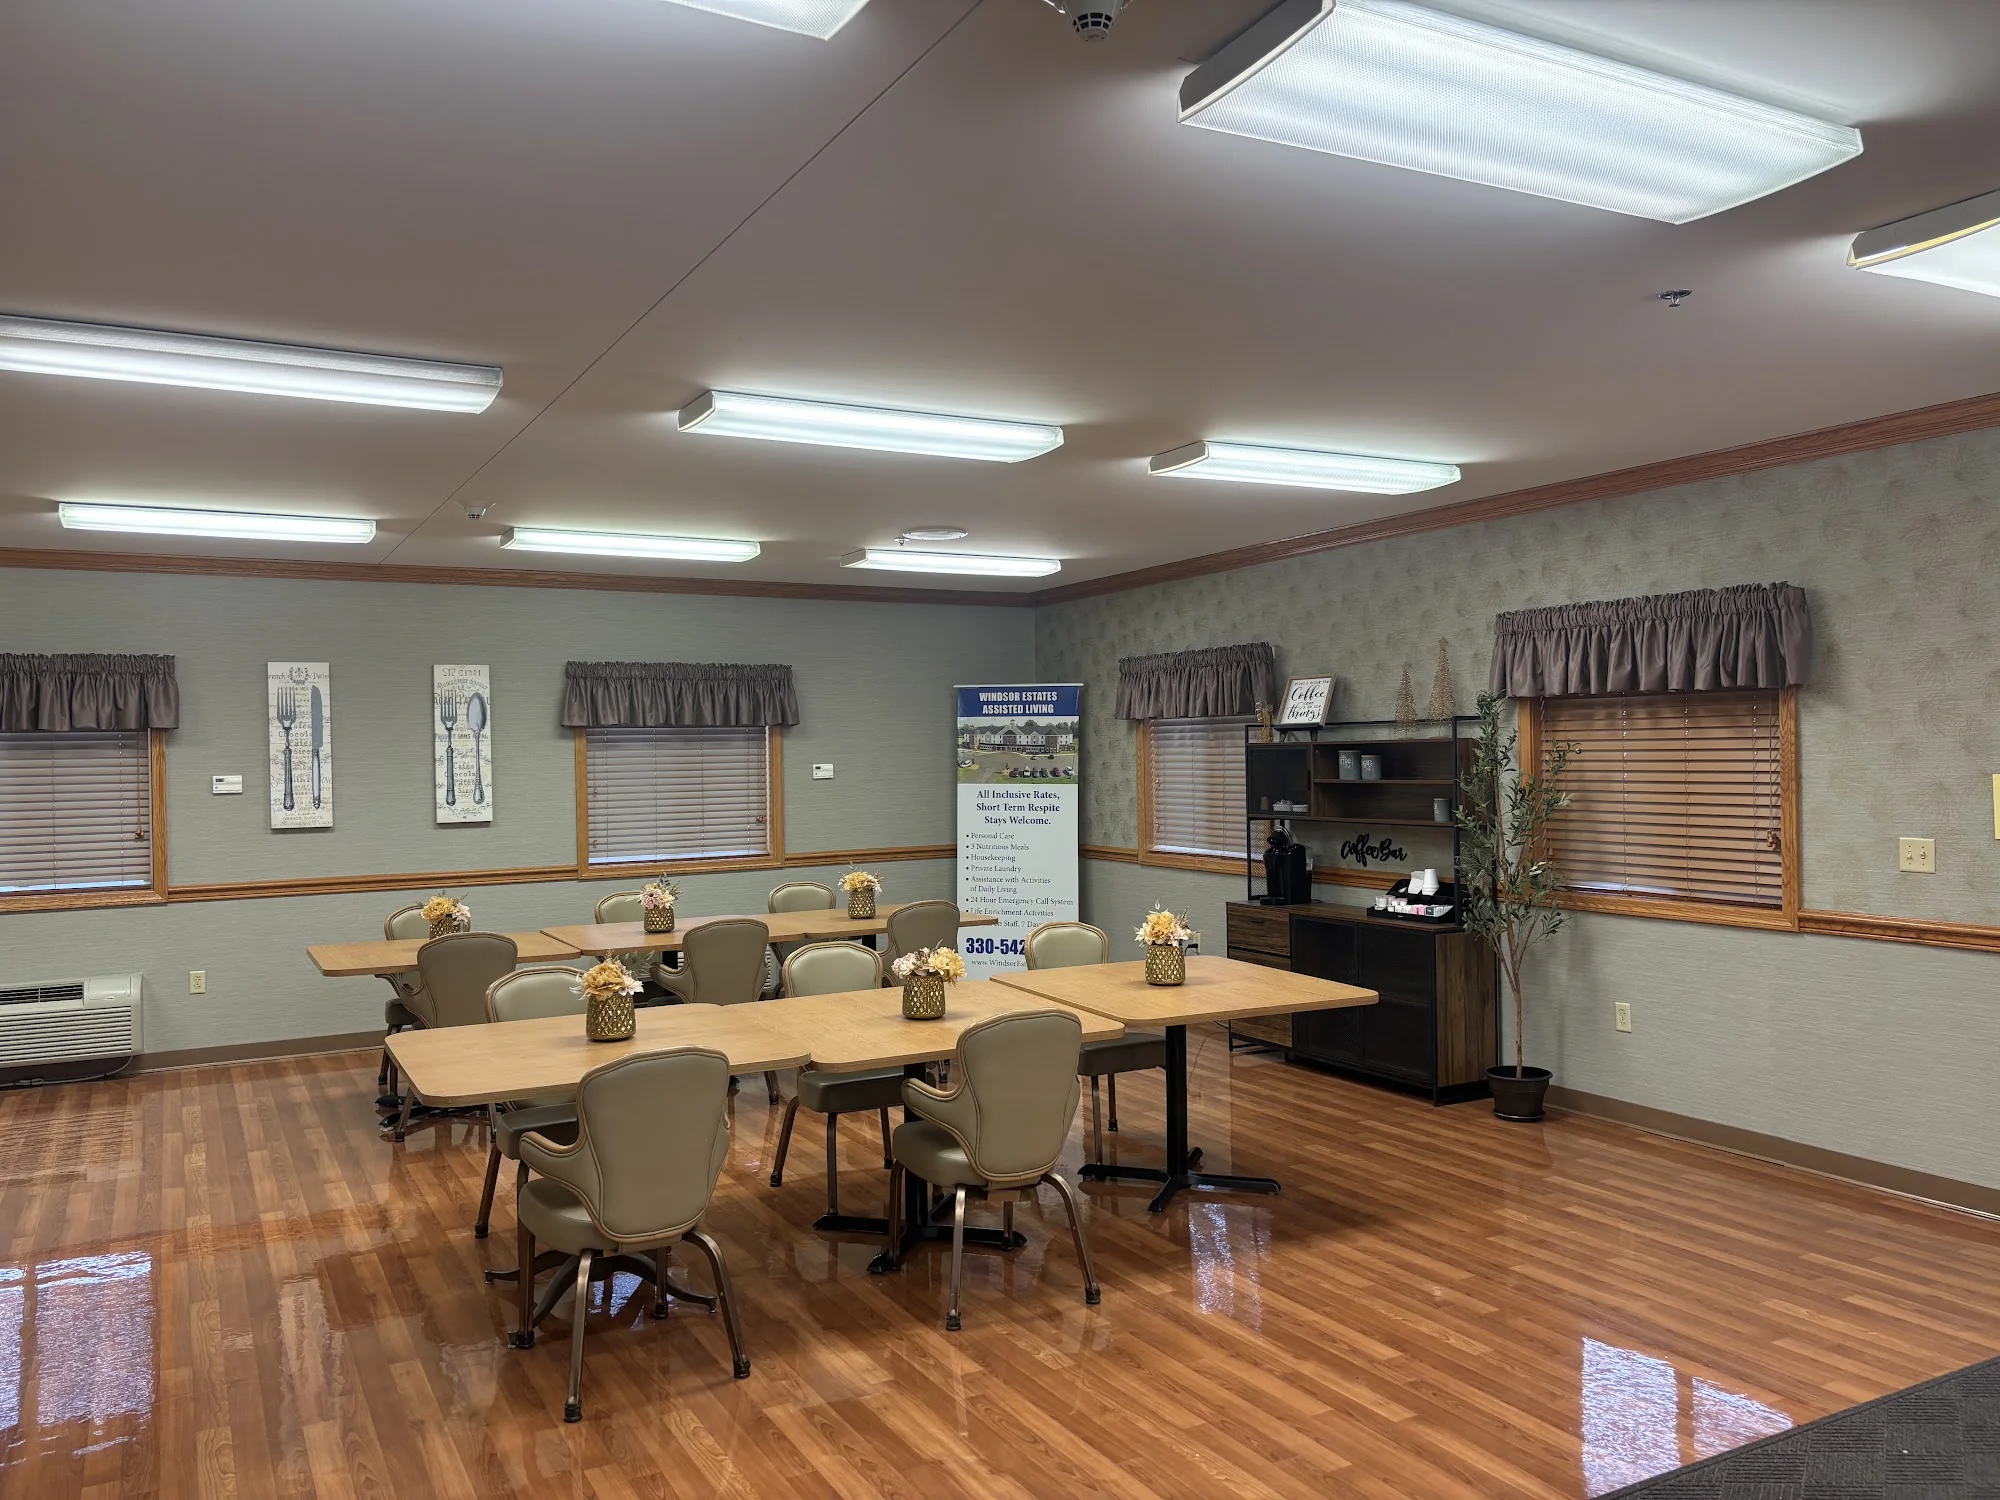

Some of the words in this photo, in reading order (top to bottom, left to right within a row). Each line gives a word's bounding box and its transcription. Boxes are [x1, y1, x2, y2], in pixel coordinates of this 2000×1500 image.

[979, 692, 1020, 702] WINDSOR
[1022, 692, 1058, 701] ESTATES
[1291, 684, 1326, 702] Coffee
[982, 704, 1024, 714] ASSISTED
[1026, 704, 1054, 713] LIVING
[976, 790, 990, 799] All
[992, 790, 1031, 799] Inclusive
[1033, 790, 1060, 800] Rates,
[976, 803, 1000, 812] Short
[1002, 803, 1026, 812] Term
[1028, 803, 1060, 814] Respite
[984, 816, 1007, 826] Stays
[1009, 816, 1051, 825] Welcome.
[1340, 834, 1379, 867] Coffee
[1380, 838, 1408, 862] Bar
[971, 854, 1016, 862] Housekeeping
[998, 897, 1034, 905] Emergency
[966, 937, 1026, 955] 330-542
